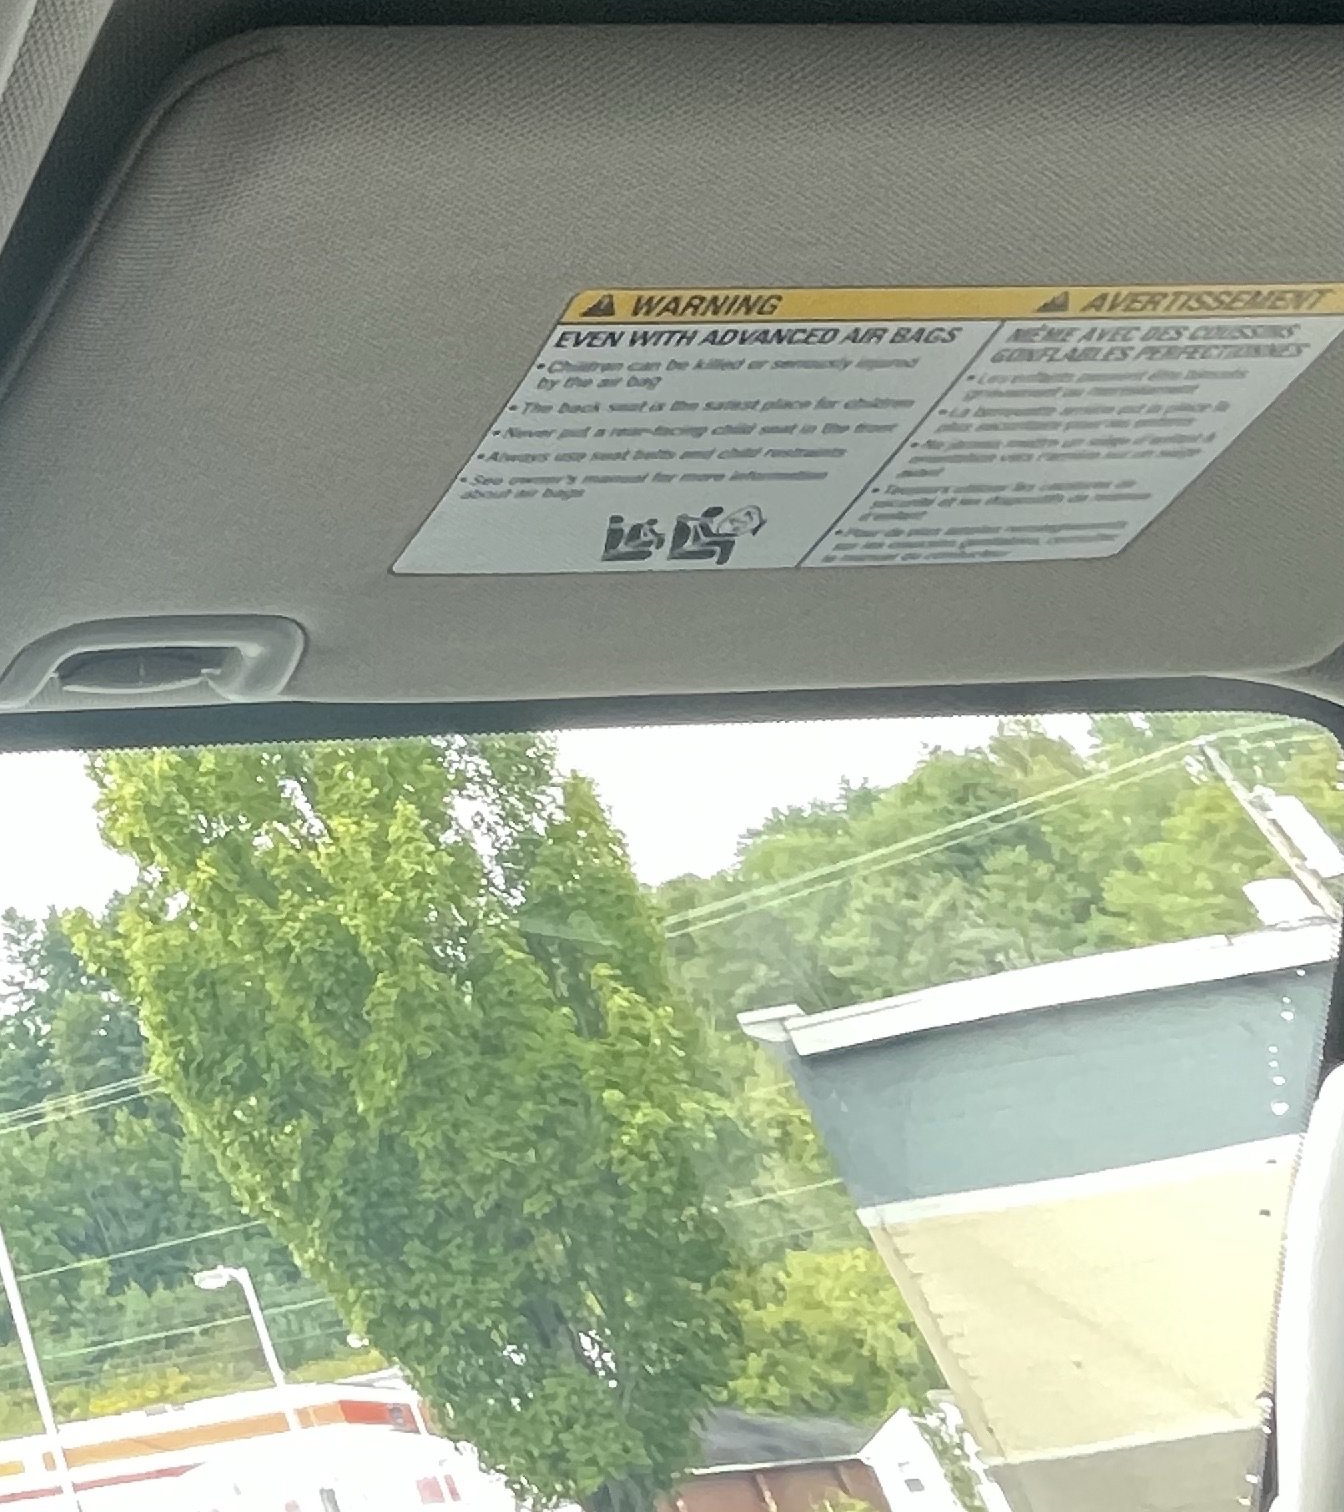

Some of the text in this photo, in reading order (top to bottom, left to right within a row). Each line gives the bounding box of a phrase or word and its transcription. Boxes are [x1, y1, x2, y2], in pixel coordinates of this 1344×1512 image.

[631, 294, 783, 317] WARNING
[1080, 289, 1335, 312] AVERTISSEMENT
[553, 326, 964, 348] EVEN WITH ADVANCED AIR BAGS
[1077, 326, 1141, 343] AVEC
[1138, 325, 1190, 342] DES
